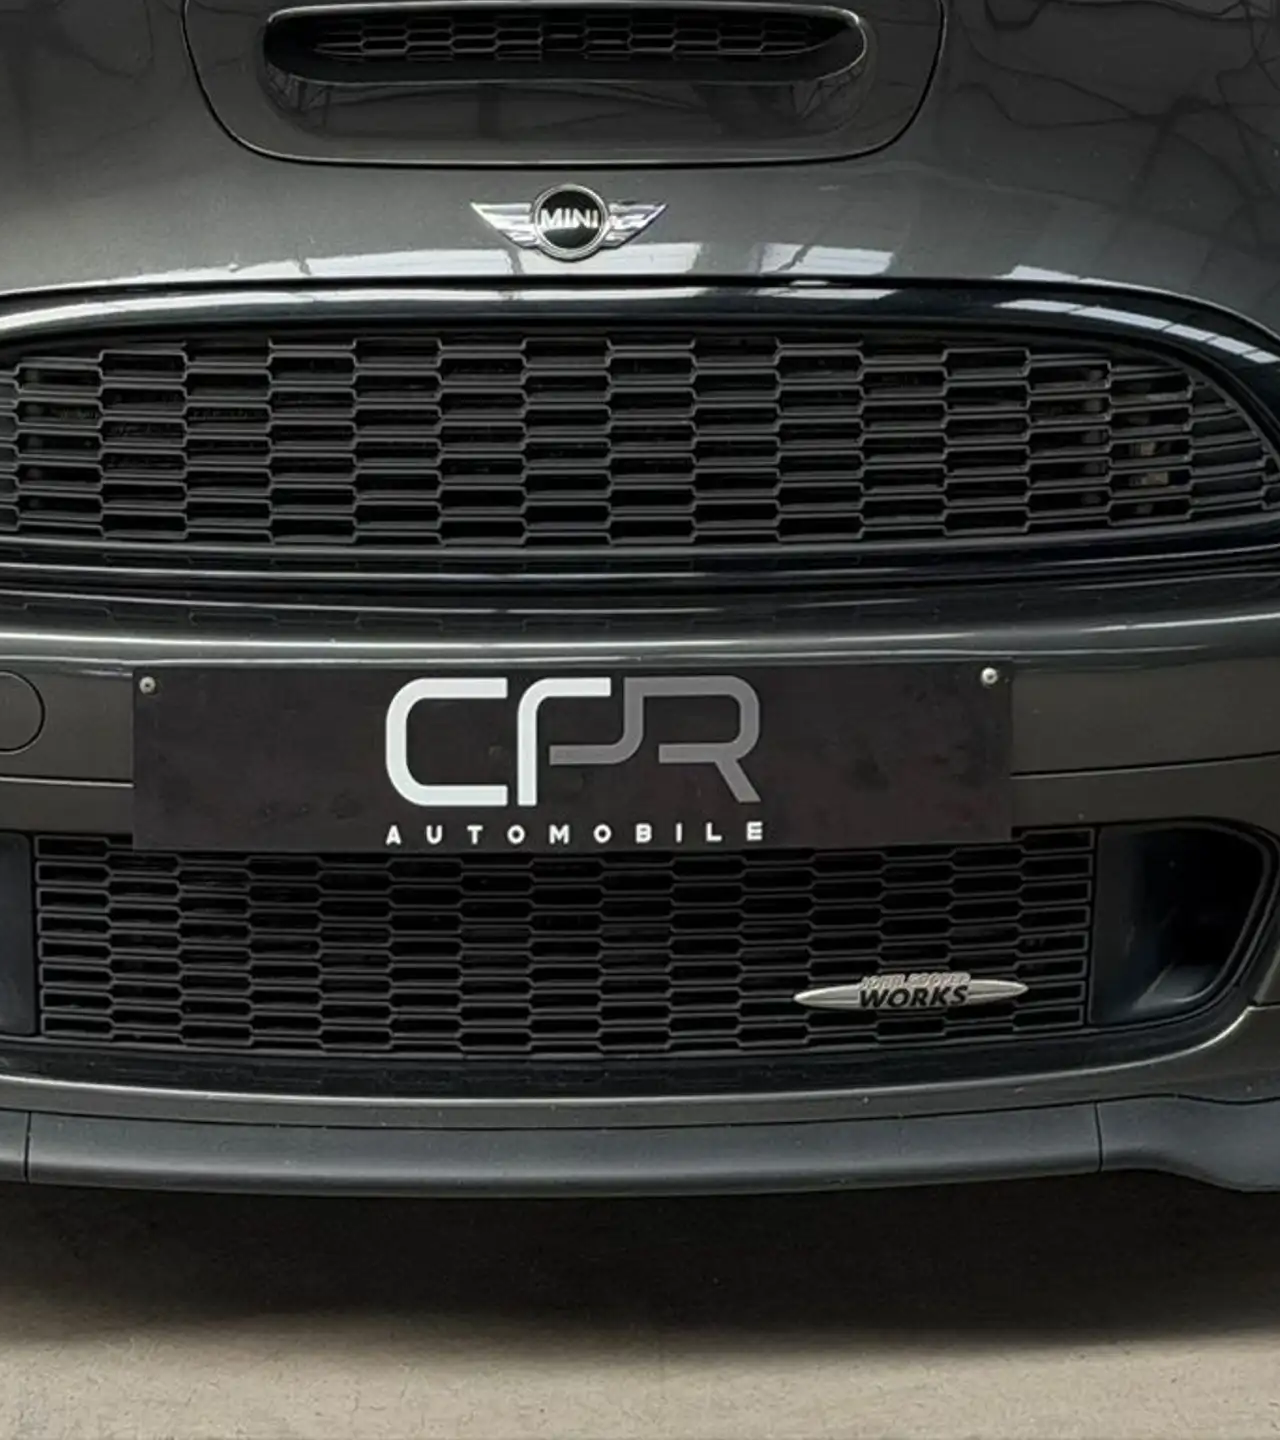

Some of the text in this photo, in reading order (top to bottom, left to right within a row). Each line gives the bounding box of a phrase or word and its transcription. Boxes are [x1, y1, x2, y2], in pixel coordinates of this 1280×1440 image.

[540, 208, 599, 229] MINI
[385, 674, 762, 807] CPR
[385, 821, 764, 846] AUTOMOBILE
[860, 984, 969, 1008] WORKS
